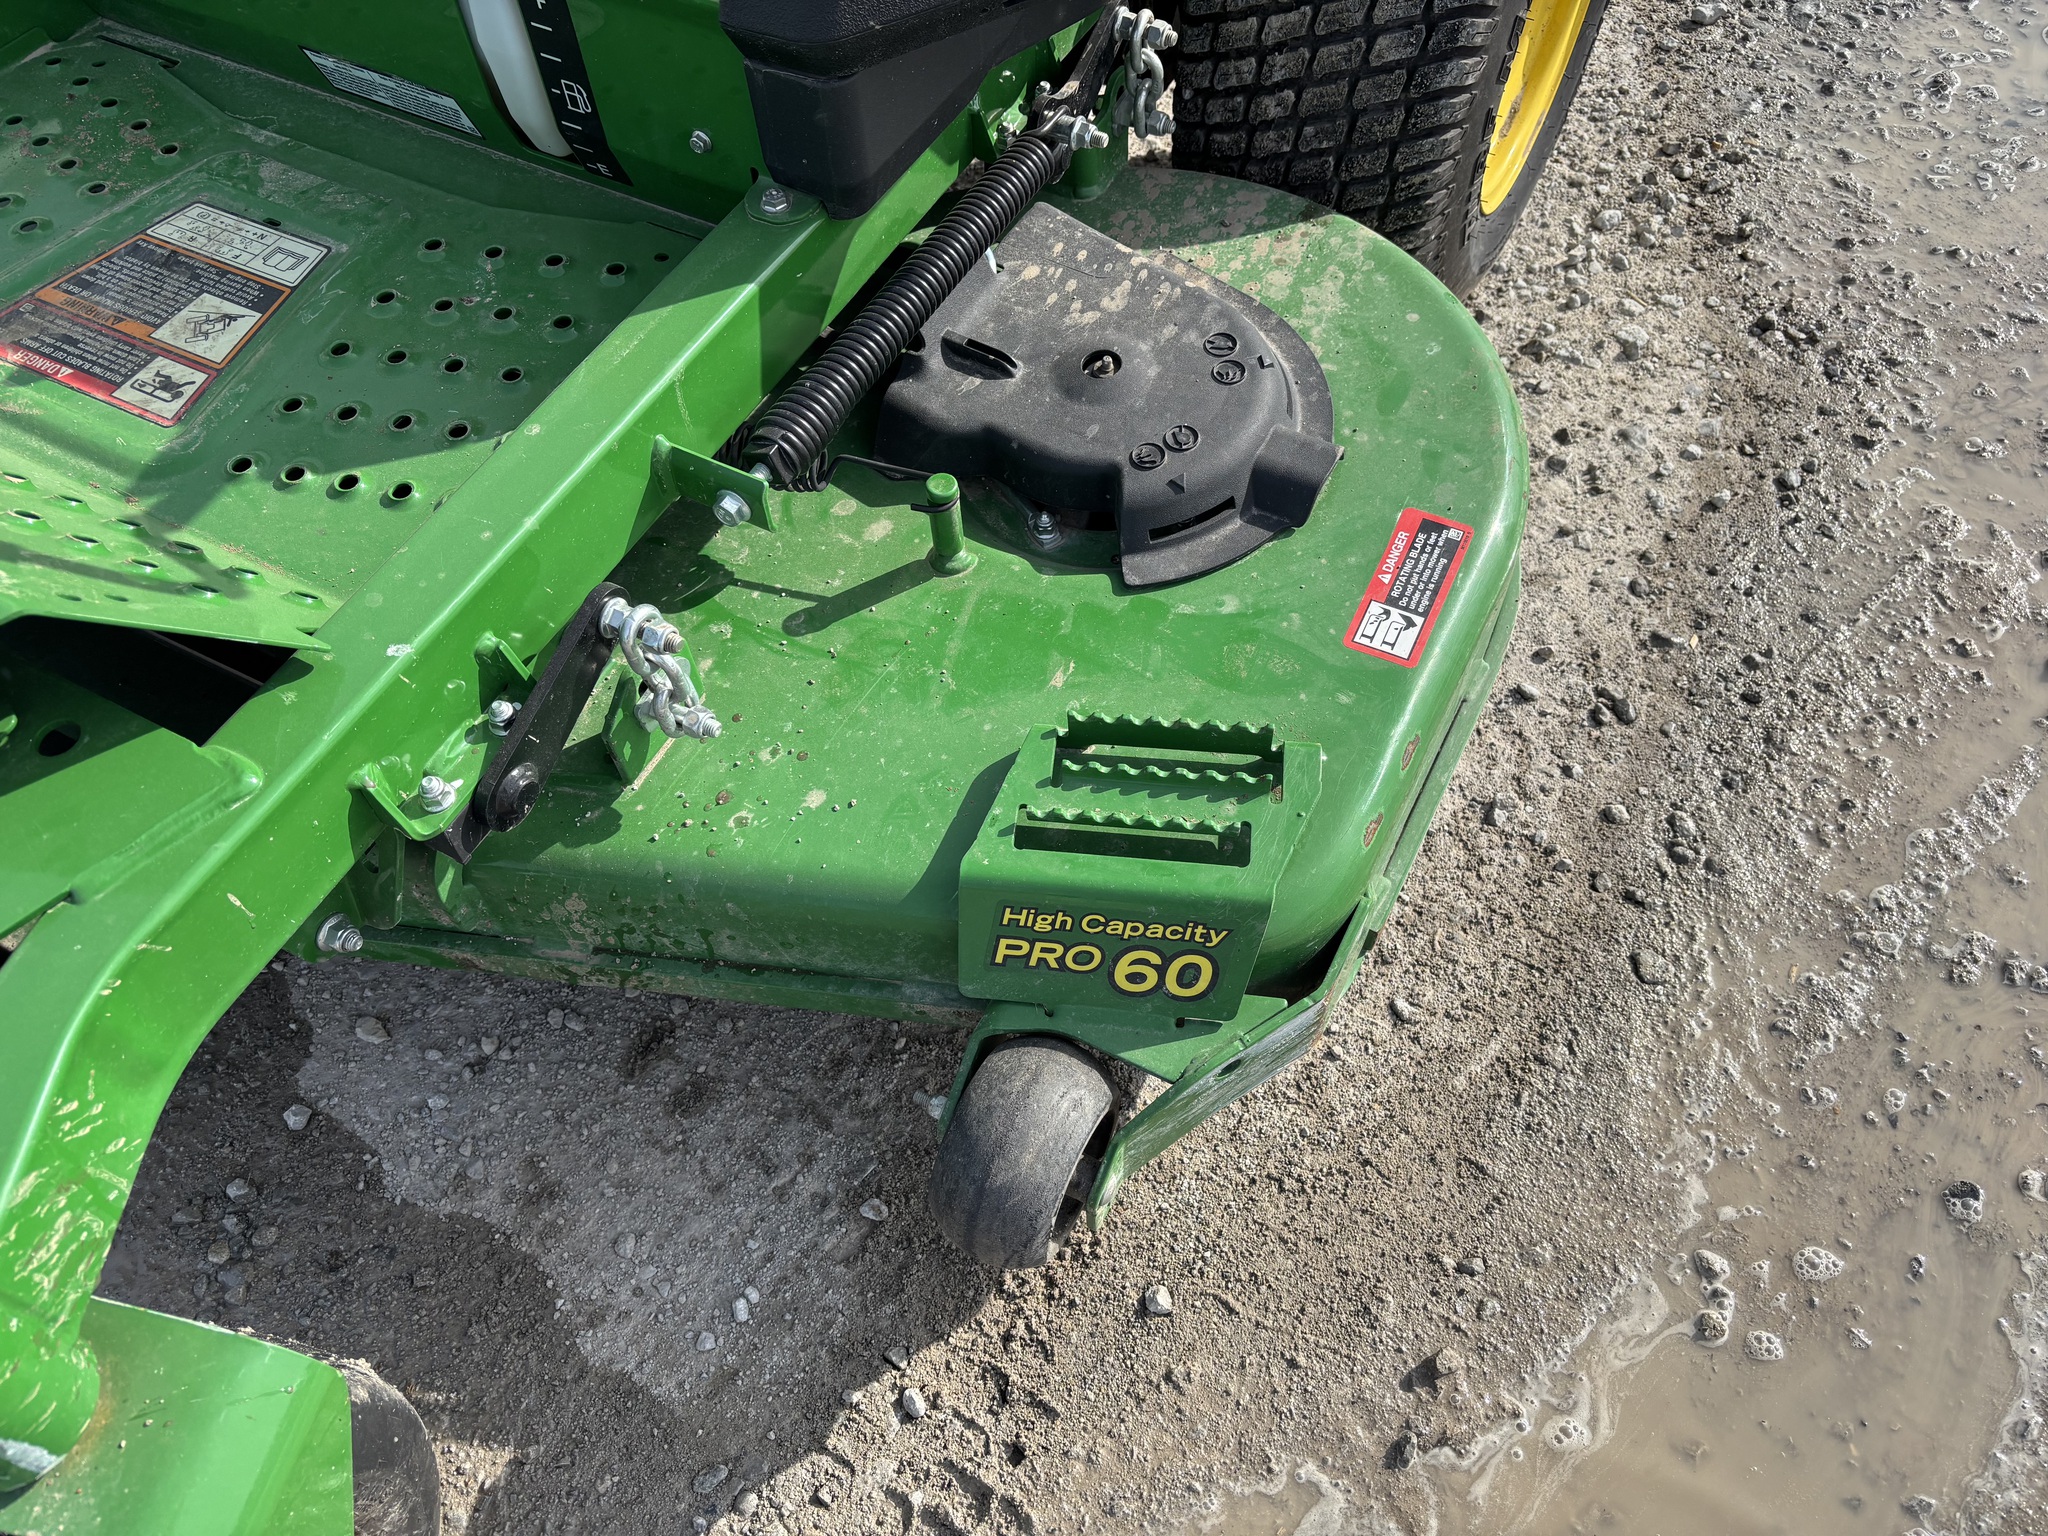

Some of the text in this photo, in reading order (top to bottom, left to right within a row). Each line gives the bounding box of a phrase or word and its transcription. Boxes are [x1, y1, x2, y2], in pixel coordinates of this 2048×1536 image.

[596, 162, 613, 178] E
[111, 257, 132, 267] working
[124, 256, 143, 265] blades
[142, 269, 158, 277] place
[150, 266, 171, 276] thrown
[81, 274, 96, 282] down
[226, 274, 261, 289] Stop engine
[60, 283, 82, 293] DEATH
[162, 283, 179, 292] safety
[200, 277, 254, 300] Avoid sudden turns
[221, 278, 242, 289] leaving
[179, 290, 193, 298] Keep
[202, 285, 224, 295] objects
[243, 287, 259, 296] When
[90, 294, 114, 306] INJURY
[224, 293, 248, 305] Remove
[60, 297, 114, 322] WARNING
[113, 303, 142, 316] SERIOUS
[153, 309, 168, 317] Read
[160, 304, 175, 312] Drive
[141, 314, 162, 324] AVOID
[38, 335, 56, 343] others
[61, 344, 83, 354] children
[77, 343, 98, 353] reverse
[20, 337, 124, 382] ROTATING BLADES CUT OFF ARMS
[82, 352, 97, 360] when
[103, 353, 117, 361] mow
[12, 350, 60, 373] DANGER
[96, 358, 111, 366] mow
[1427, 532, 1438, 544] feet
[1383, 532, 1409, 572] DANGER
[1391, 533, 1426, 597] ROTATING BLADE
[1414, 553, 1428, 572] hands
[1409, 590, 1421, 609] under
[1420, 569, 1431, 581] into
[1428, 547, 1441, 568] mower
[1437, 530, 1448, 546] when
[1410, 573, 1419, 585] put
[1418, 590, 1431, 612] engine
[1431, 558, 1447, 582] running
[1405, 585, 1414, 596] not
[1399, 597, 1408, 606] Do
[999, 906, 1230, 948] High Capacity
[992, 936, 1216, 1000] PRO 60
